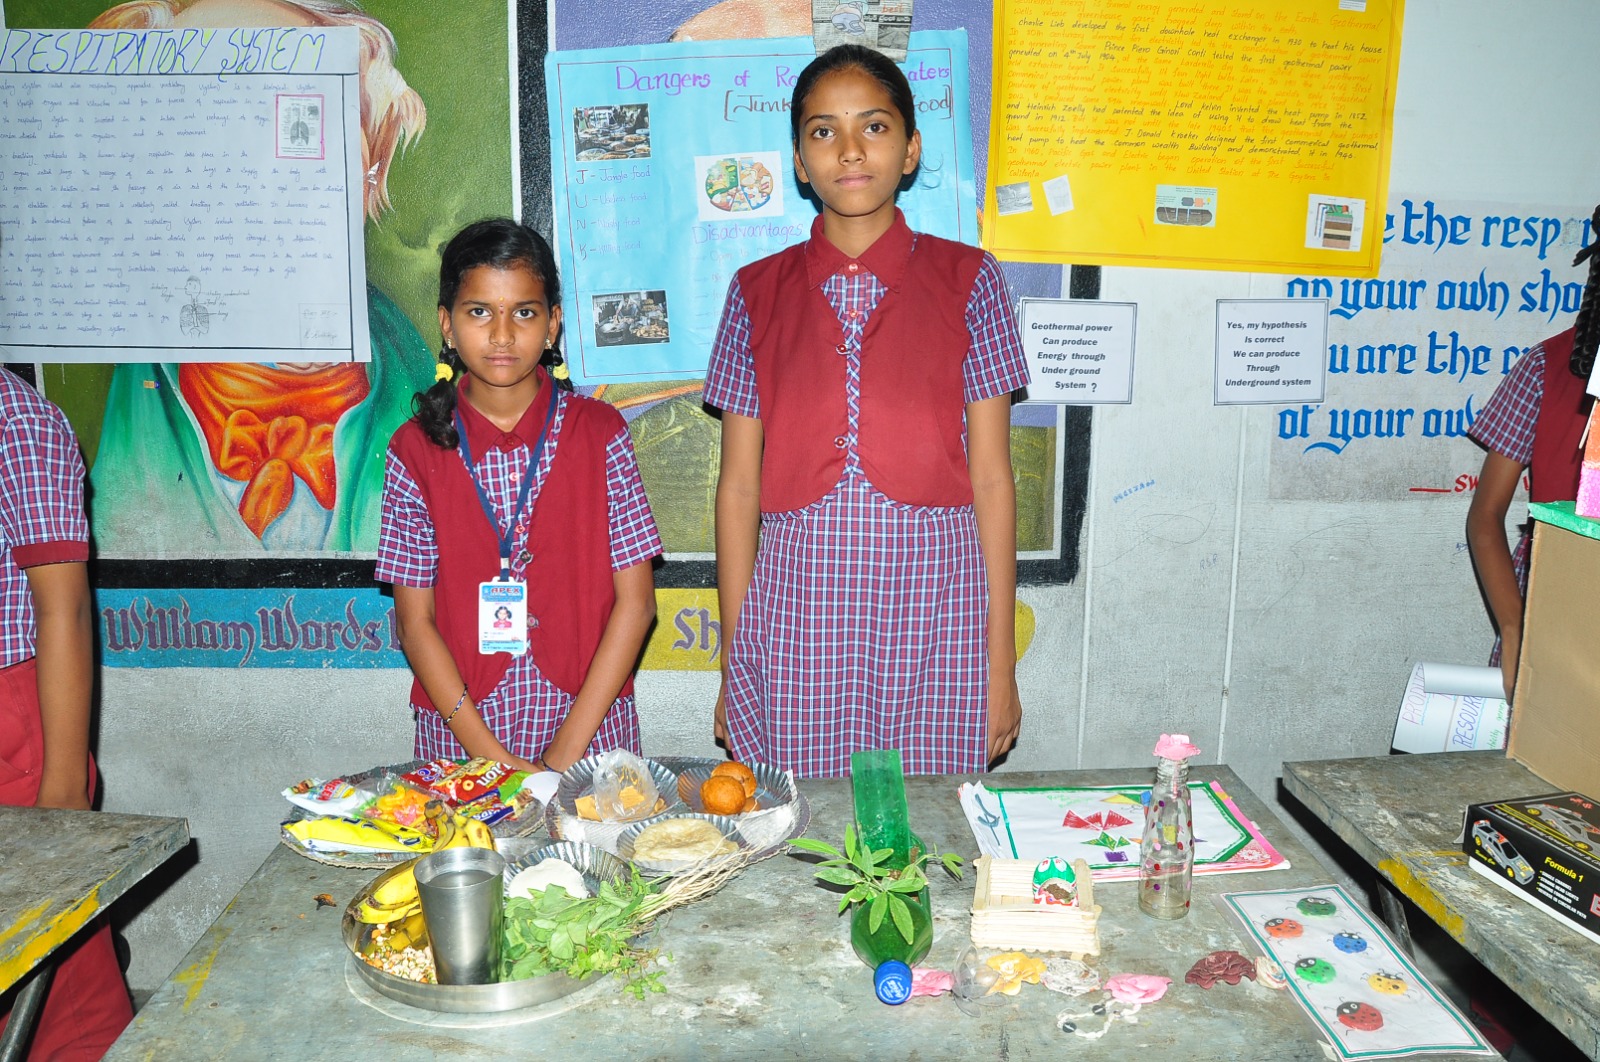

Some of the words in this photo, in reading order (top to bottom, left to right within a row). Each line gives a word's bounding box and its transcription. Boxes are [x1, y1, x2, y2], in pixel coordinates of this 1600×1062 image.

[1072, 20, 1108, 32] developed
[1115, 22, 1126, 31] the
[1132, 23, 1150, 33] first
[1160, 26, 1195, 36] downhole
[1204, 29, 1220, 38] heat
[1228, 32, 1266, 46] exchanger
[1322, 40, 1340, 50] heat
[1343, 42, 1354, 51] his
[218, 27, 326, 82] SYSTEM
[1008, 49, 1042, 60] generated
[1212, 50, 1234, 61] tested
[1241, 54, 1252, 62] the
[1259, 55, 1276, 65] first
[1283, 58, 1324, 70] geothermal
[1328, 64, 1352, 73] power
[615, 65, 711, 96] Dangers
[734, 70, 750, 87] of
[1006, 101, 1020, 110] and
[1093, 105, 1107, 113] had
[1113, 106, 1144, 116] patented
[1150, 108, 1161, 116] the
[1168, 108, 1184, 117] idea
[1193, 110, 1201, 119] of
[1209, 113, 1229, 125] using
[1247, 115, 1254, 123] to
[1261, 116, 1282, 124] draw
[1289, 118, 1306, 127] heat
[1311, 119, 1332, 128] from
[1229, 103, 1260, 113] invented
[1283, 108, 1302, 117] heat
[1309, 112, 1330, 121] pump
[1007, 133, 1023, 142] heat
[1029, 137, 1049, 147] pump
[1070, 136, 1087, 145] heat
[1152, 141, 1179, 150] wealth
[1188, 143, 1218, 157] Building
[1228, 144, 1244, 153] and
[1320, 149, 1327, 157] in
[1137, 129, 1162, 138] Donald
[1205, 132, 1237, 147] designed
[1244, 136, 1255, 144] the
[1260, 135, 1277, 145] first
[632, 164, 651, 180] food
[692, 222, 804, 245] Disadvantages
[1401, 199, 1472, 254] the
[1330, 278, 1427, 320] your
[1436, 266, 1510, 321] own
[1031, 322, 1083, 331] Geothermal
[1227, 321, 1245, 330] Yes,
[1247, 322, 1260, 330] my
[1261, 321, 1307, 330] hypothesis
[1042, 337, 1059, 345] Can
[1061, 338, 1098, 346] produce
[1037, 351, 1067, 361] Energy
[1071, 353, 1106, 361] through
[1233, 350, 1246, 358] We
[1266, 350, 1301, 358] produce
[1356, 344, 1417, 375] are
[1425, 330, 1492, 383] the
[1041, 366, 1068, 374] Under
[1069, 368, 1101, 376] ground
[1246, 364, 1280, 373] Through
[1055, 381, 1086, 390] System
[1091, 382, 1098, 393] ?
[1225, 379, 1280, 388] Underground
[1282, 379, 1312, 387] system
[1303, 407, 1414, 455] your
[101, 595, 256, 668] William
[1544, 856, 1577, 879] Formula
